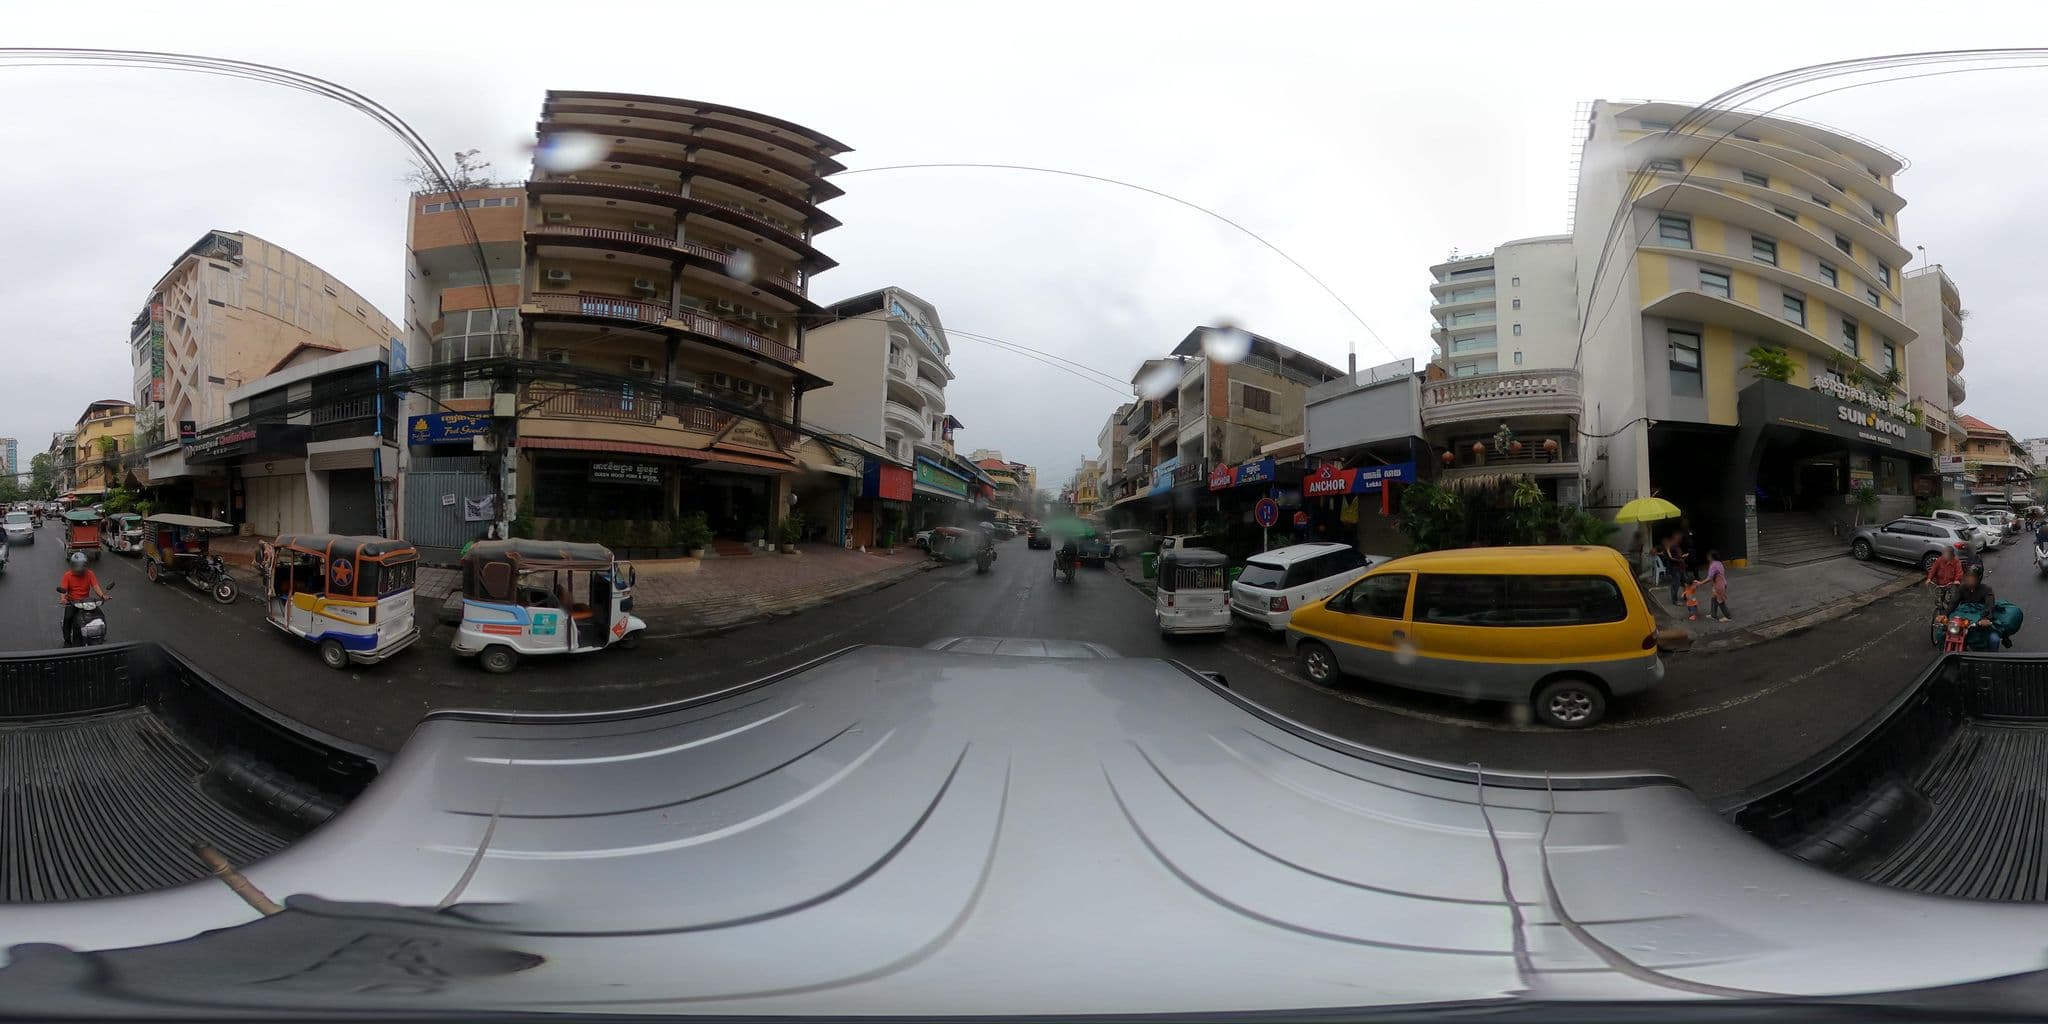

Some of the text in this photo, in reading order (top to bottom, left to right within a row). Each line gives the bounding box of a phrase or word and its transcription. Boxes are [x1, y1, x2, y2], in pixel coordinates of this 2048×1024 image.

[1838, 405, 1867, 427] SUN
[1875, 417, 1906, 439] MOON
[1310, 479, 1345, 492] ANCHOR
